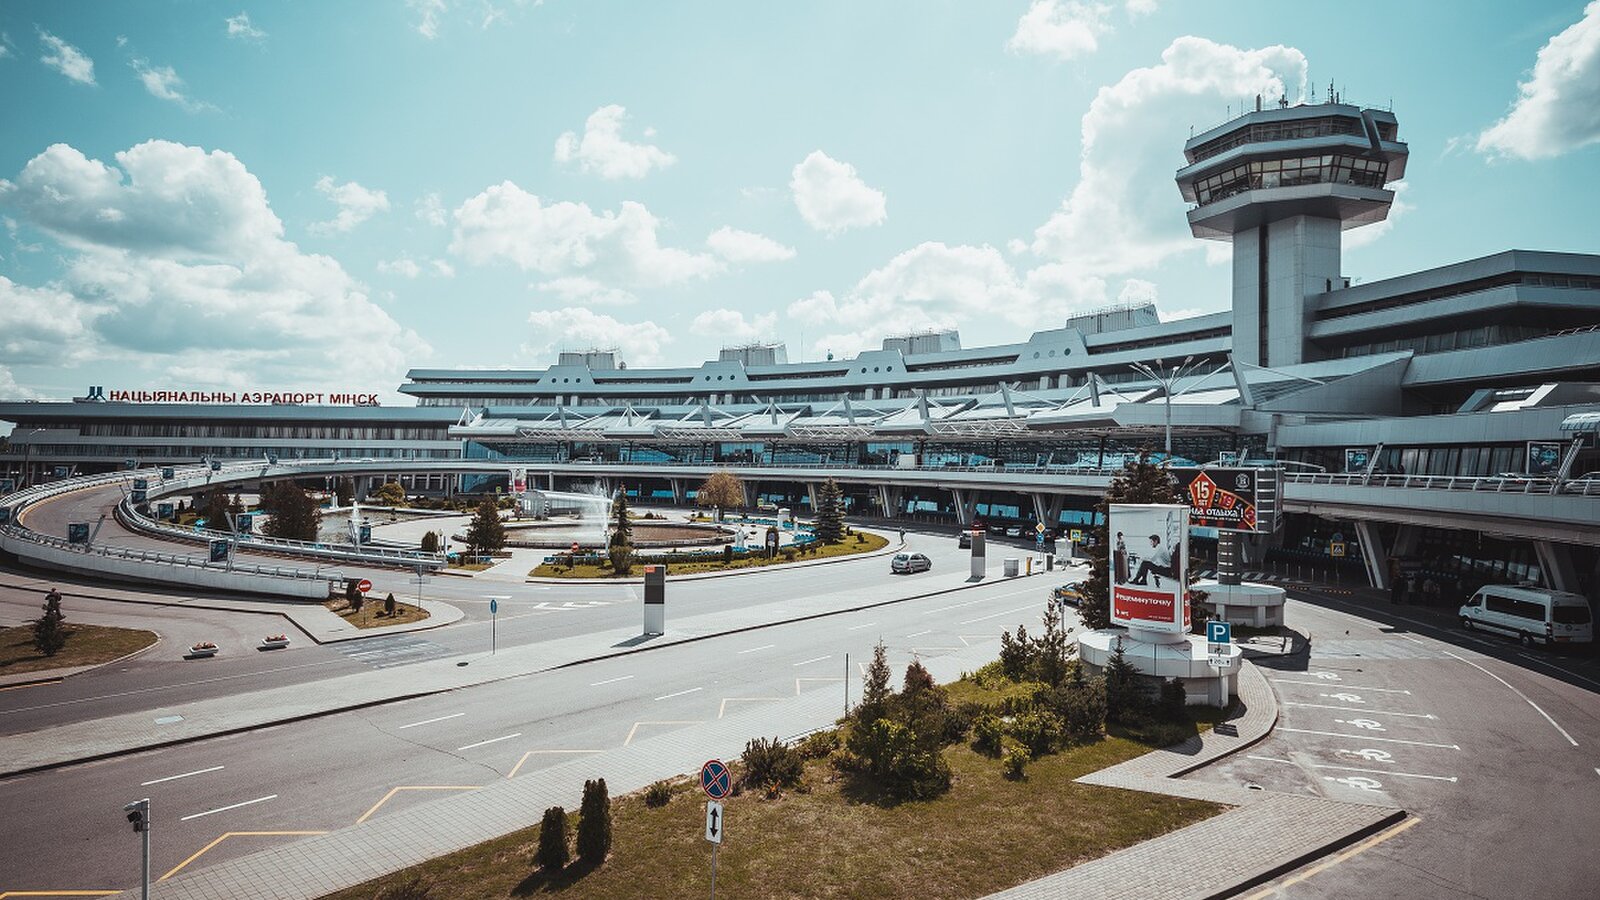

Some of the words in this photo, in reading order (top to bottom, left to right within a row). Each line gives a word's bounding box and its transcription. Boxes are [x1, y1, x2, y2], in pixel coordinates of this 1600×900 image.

[109, 390, 236, 403] НАЦЫЯНАЛЬНЫ
[241, 392, 324, 404] АЭРАПОРТ
[329, 394, 379, 404] МІНСК
[1195, 481, 1210, 499] 15
[1214, 625, 1226, 641] P
